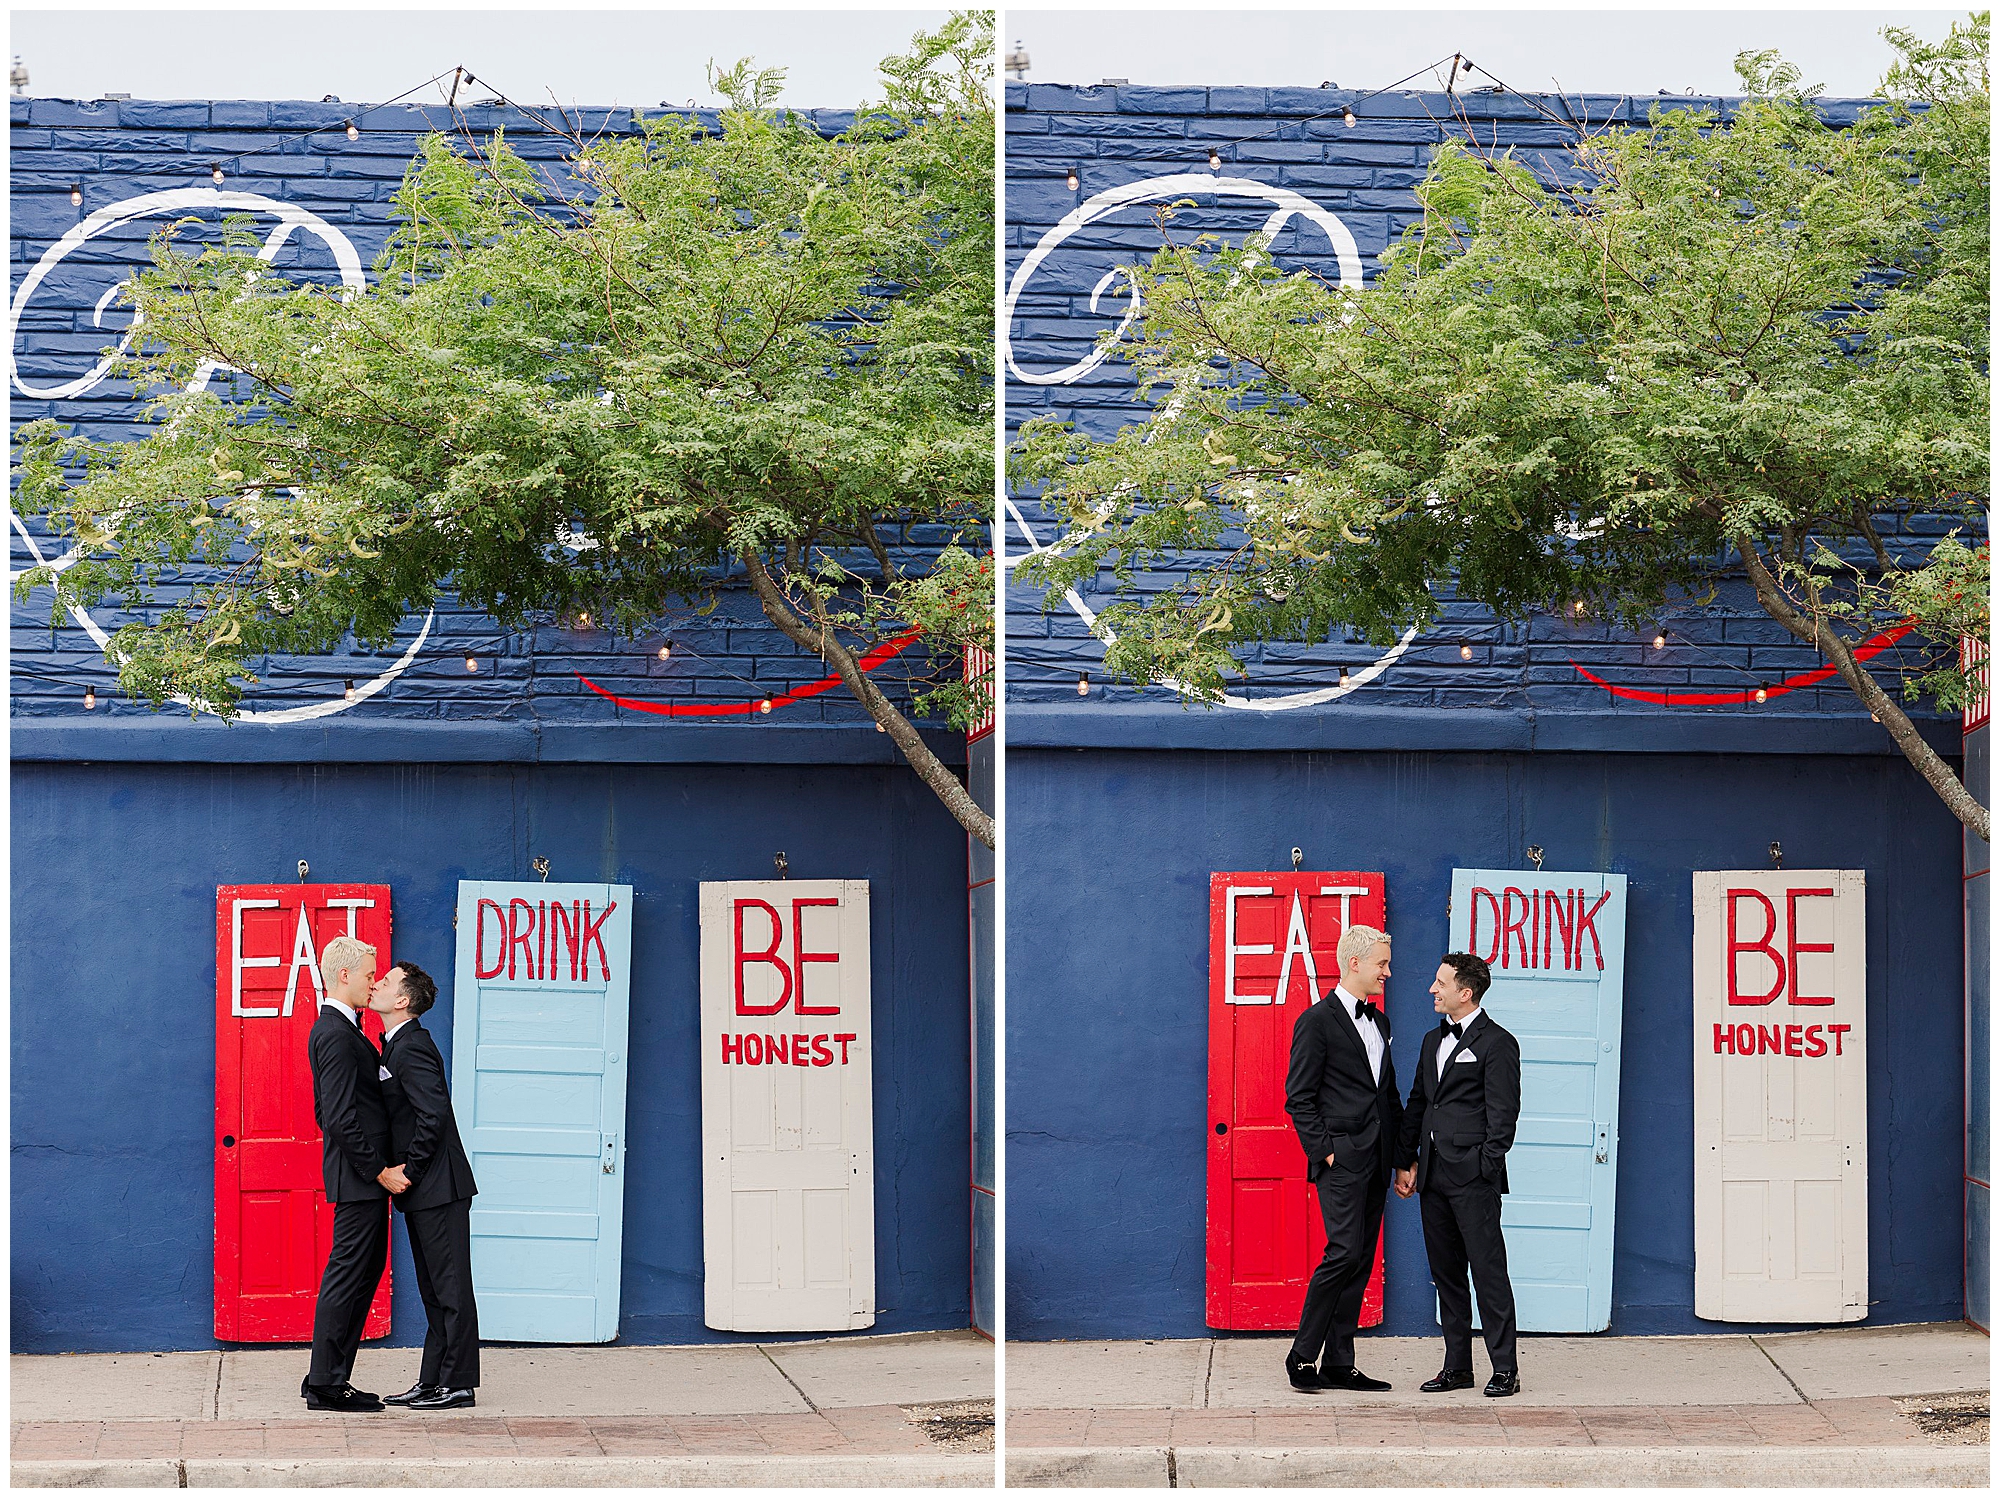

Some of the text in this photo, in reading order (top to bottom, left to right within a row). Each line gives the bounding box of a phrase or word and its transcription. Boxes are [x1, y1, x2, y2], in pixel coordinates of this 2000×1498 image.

[475, 897, 617, 982] DRINK
[733, 897, 841, 1016] BE
[1468, 886, 1611, 970] DRINK
[1726, 887, 1835, 1006] BE
[721, 1033, 857, 1068] HONEST
[1713, 1023, 1851, 1058] HONEST
